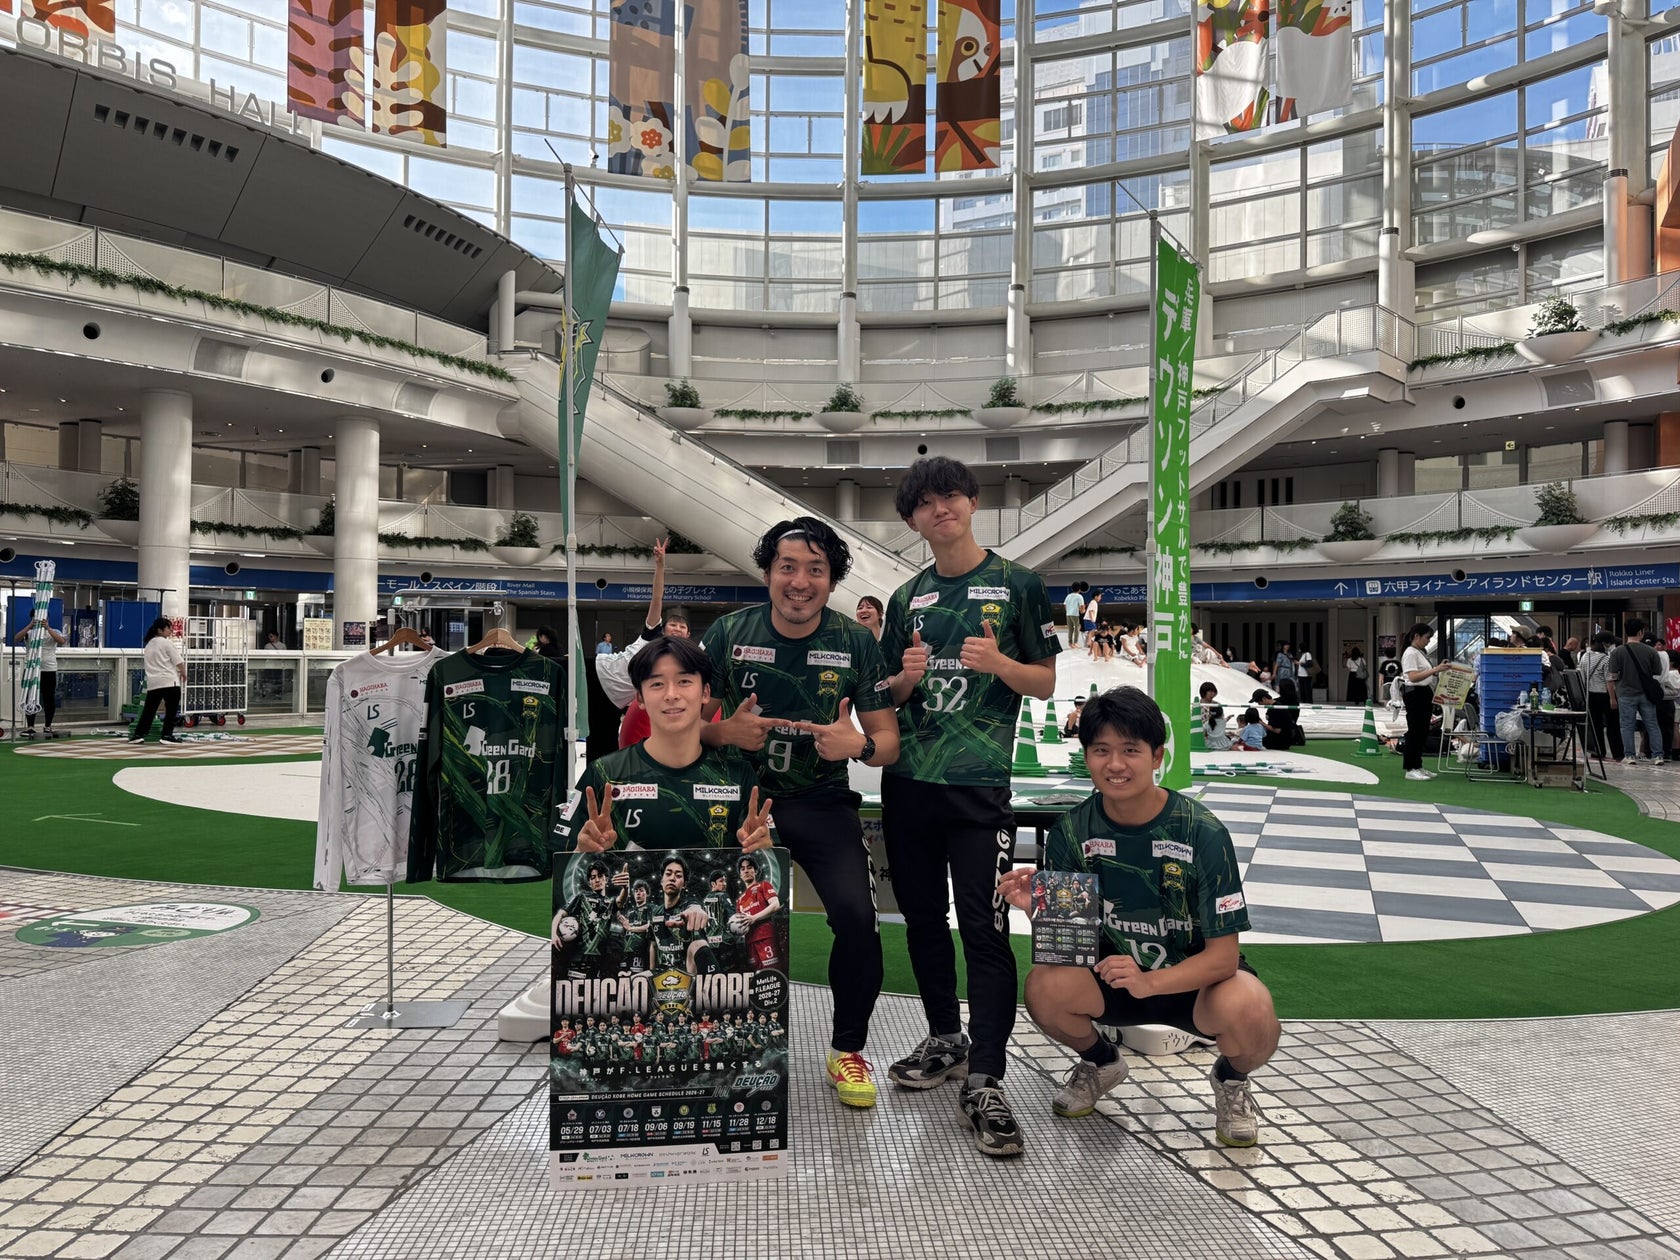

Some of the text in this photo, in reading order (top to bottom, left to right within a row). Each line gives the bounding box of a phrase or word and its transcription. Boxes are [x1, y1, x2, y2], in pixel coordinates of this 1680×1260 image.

[16, 15, 311, 138] ORBIS HALL
[1153, 287, 1178, 655] デウソン神戸
[1384, 571, 1603, 593] 六甲ライナー アイランドセンター駅
[1662, 576, 1677, 584] Sta.
[518, 589, 539, 597] Spanish
[808, 653, 850, 662] MILKCROWN
[512, 680, 549, 690] MILKCROWN
[741, 671, 759, 689] LS
[922, 676, 968, 713] 32
[367, 704, 380, 720] LS
[463, 702, 476, 718] LS
[768, 739, 792, 773] 9
[695, 786, 739, 794] MILKCROWN
[624, 808, 643, 828] LS
[764, 945, 774, 959] 3
[1124, 938, 1168, 970] 12
[707, 964, 716, 973] LS
[756, 975, 777, 985] MetLife
[696, 972, 755, 1012] KOBE
[755, 982, 781, 993] F.LEAGUE
[763, 998, 778, 1006] Div.2
[1161, 1032, 1195, 1051] デウソ
[673, 1121, 695, 1130] 09/19
[702, 1119, 721, 1128] 11/15
[729, 1118, 749, 1127] 11/28
[756, 1116, 777, 1125] 12/18
[560, 1126, 584, 1135] 05/29
[589, 1125, 612, 1133] 07/03
[617, 1124, 639, 1132] 07/18
[702, 1147, 710, 1156] LS
